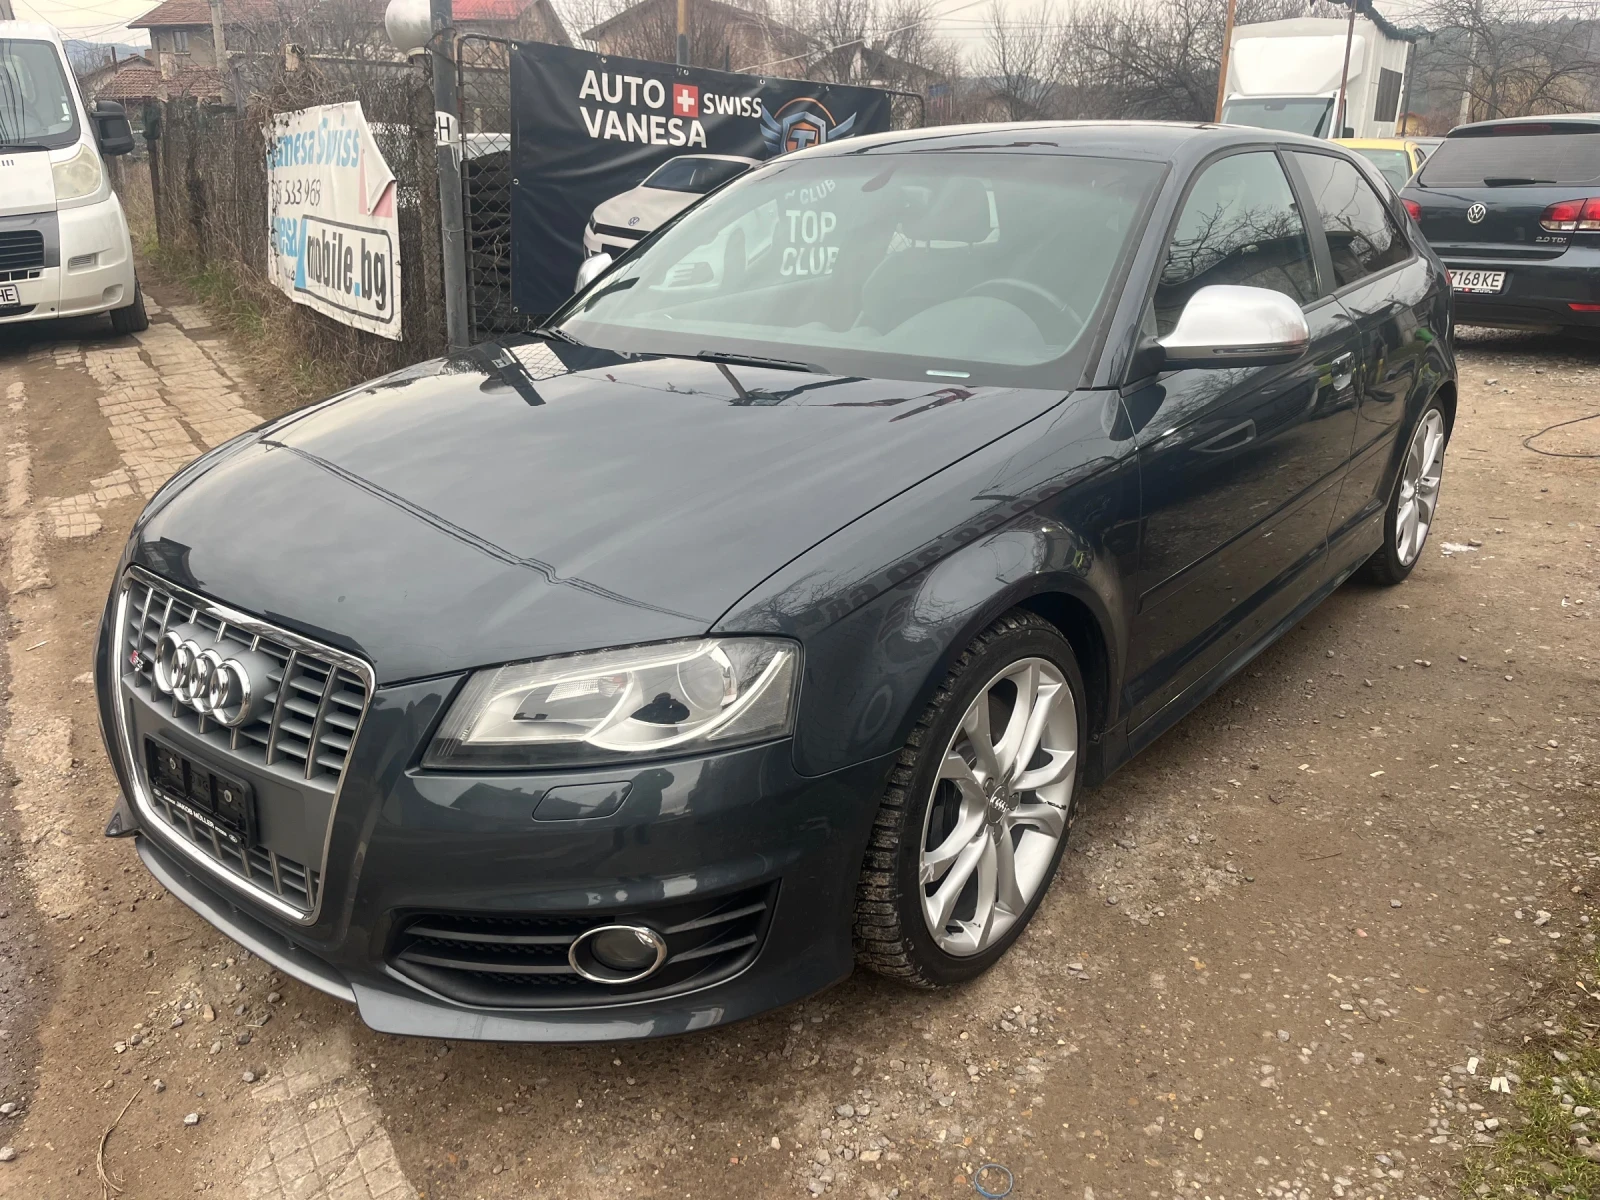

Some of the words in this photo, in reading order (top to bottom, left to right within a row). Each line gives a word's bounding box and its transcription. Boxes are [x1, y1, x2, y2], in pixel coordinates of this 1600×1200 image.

[578, 69, 666, 109] AUTO
[703, 92, 762, 118] SWISS
[316, 116, 360, 168] Swiss
[580, 106, 707, 149] VANESA
[785, 209, 837, 244] TOP
[307, 228, 387, 312] mobile.bg
